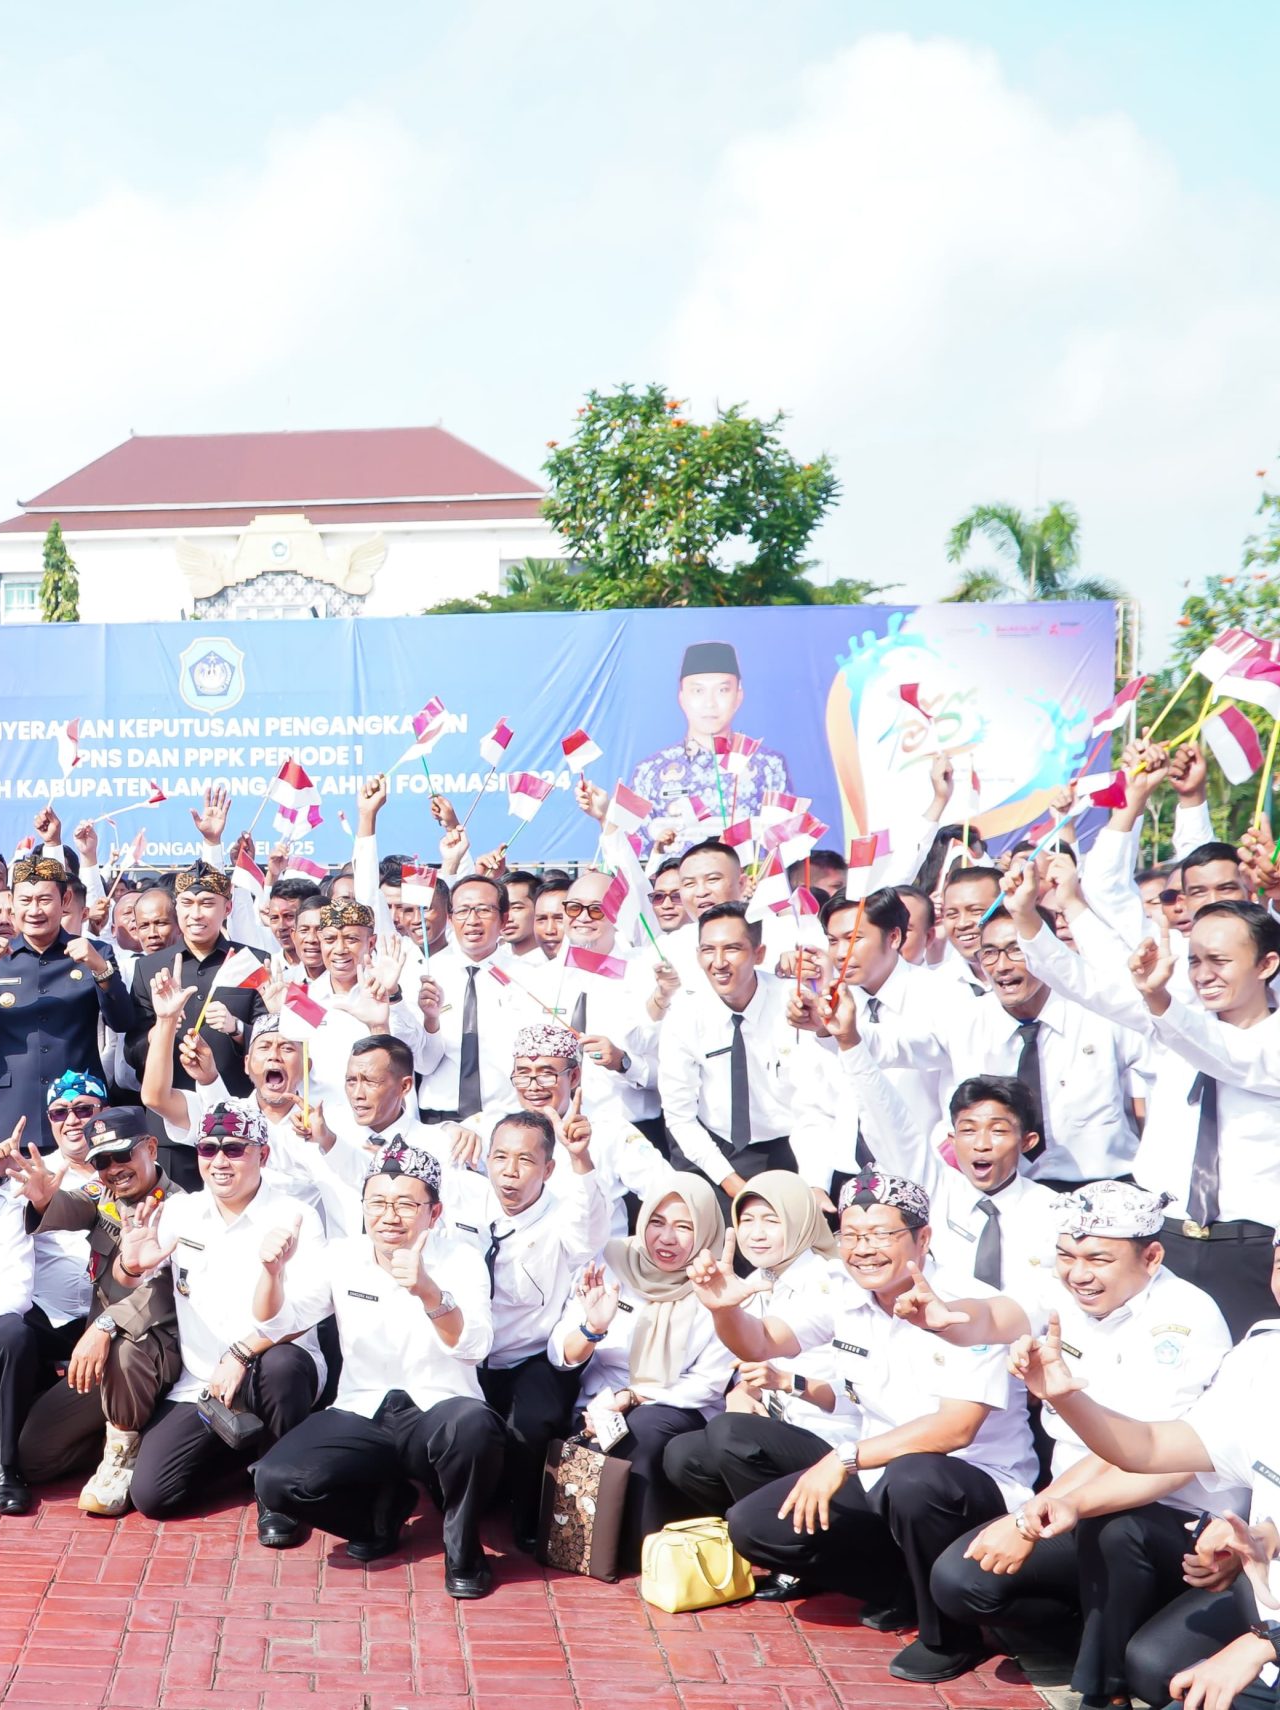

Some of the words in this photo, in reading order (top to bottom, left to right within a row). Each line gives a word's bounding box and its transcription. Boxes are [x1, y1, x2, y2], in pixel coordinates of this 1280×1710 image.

[119, 717, 260, 739] KEPUTUSAN
[265, 713, 468, 738] PENGANGKAN
[65, 748, 122, 769] PNS
[127, 747, 180, 768] DAN
[184, 747, 246, 768] PPPK
[249, 745, 350, 767] PERIODE
[354, 745, 364, 766] 1
[17, 776, 157, 799] KABUPATEN
[162, 775, 292, 797] LAMONG
[396, 771, 507, 794] FORMASI
[511, 769, 572, 792] 24
